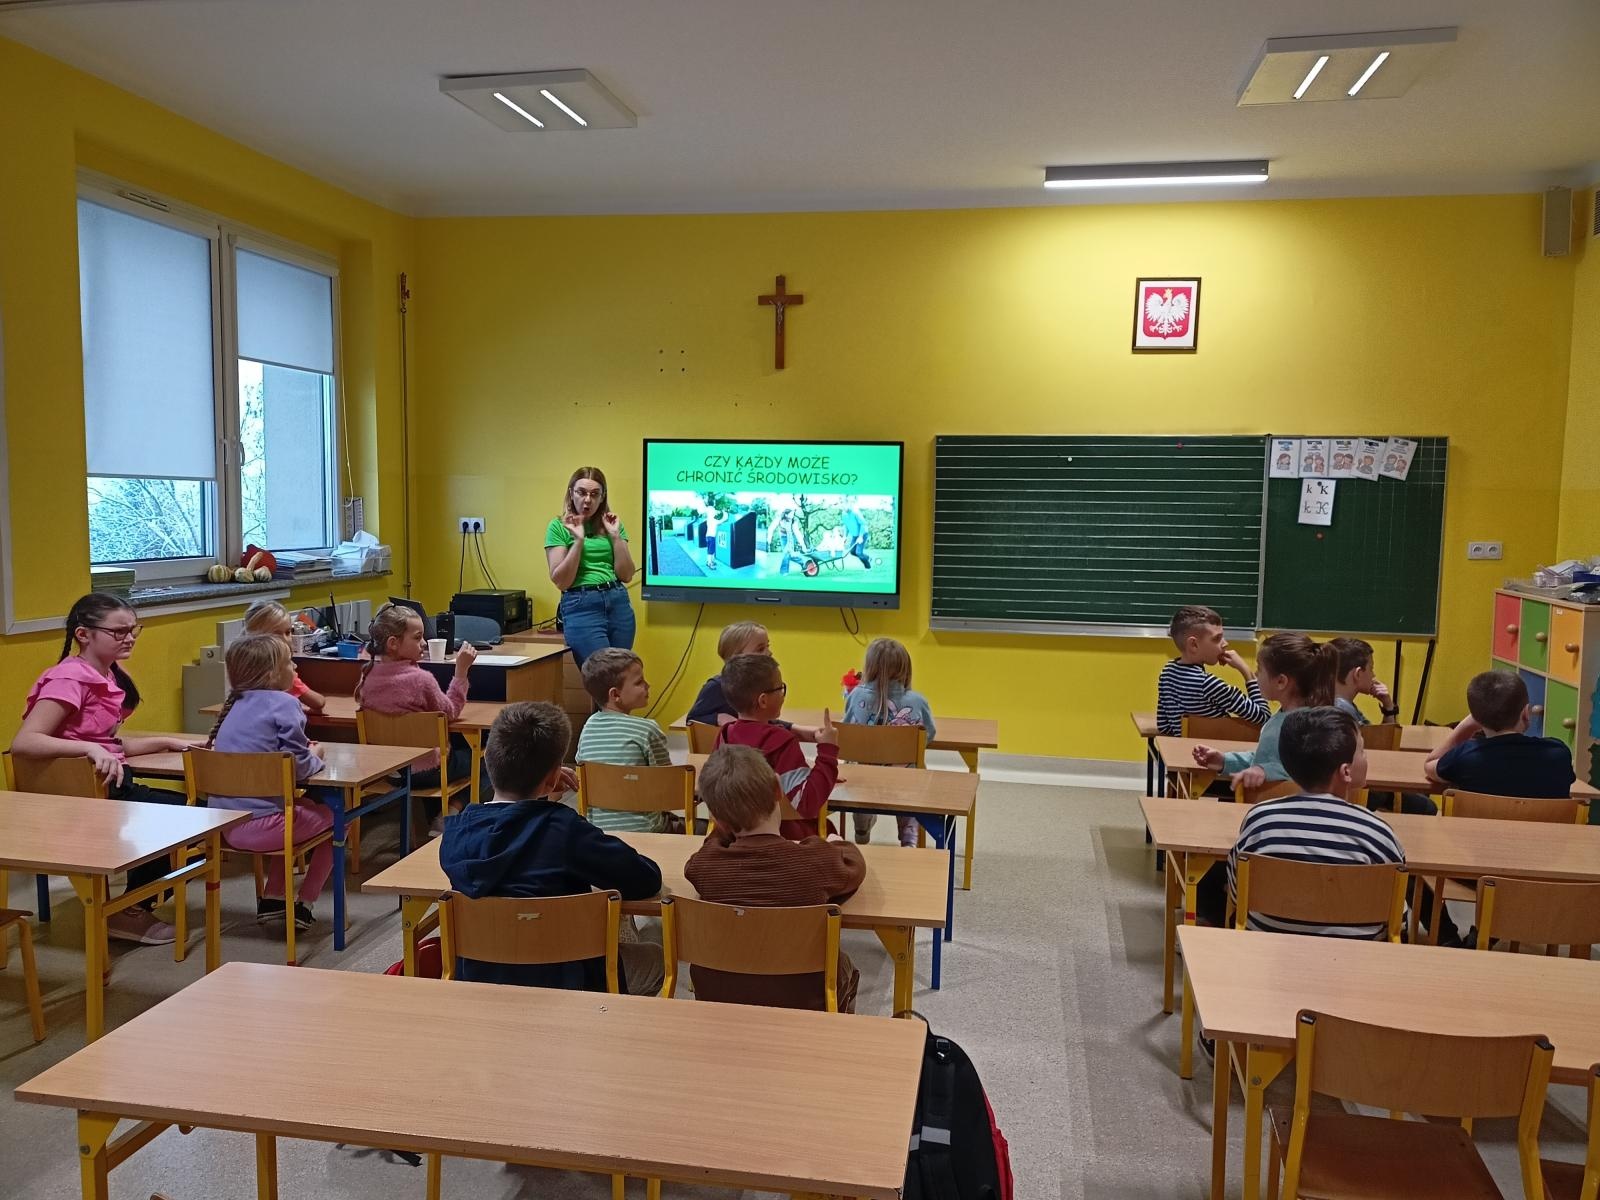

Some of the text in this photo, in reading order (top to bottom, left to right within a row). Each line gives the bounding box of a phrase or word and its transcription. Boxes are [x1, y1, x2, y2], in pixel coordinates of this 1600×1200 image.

[704, 454, 830, 470] CZY KAŻDY MOŻE
[676, 467, 858, 485] CHRONIĆ ŚRODOWISKO?
